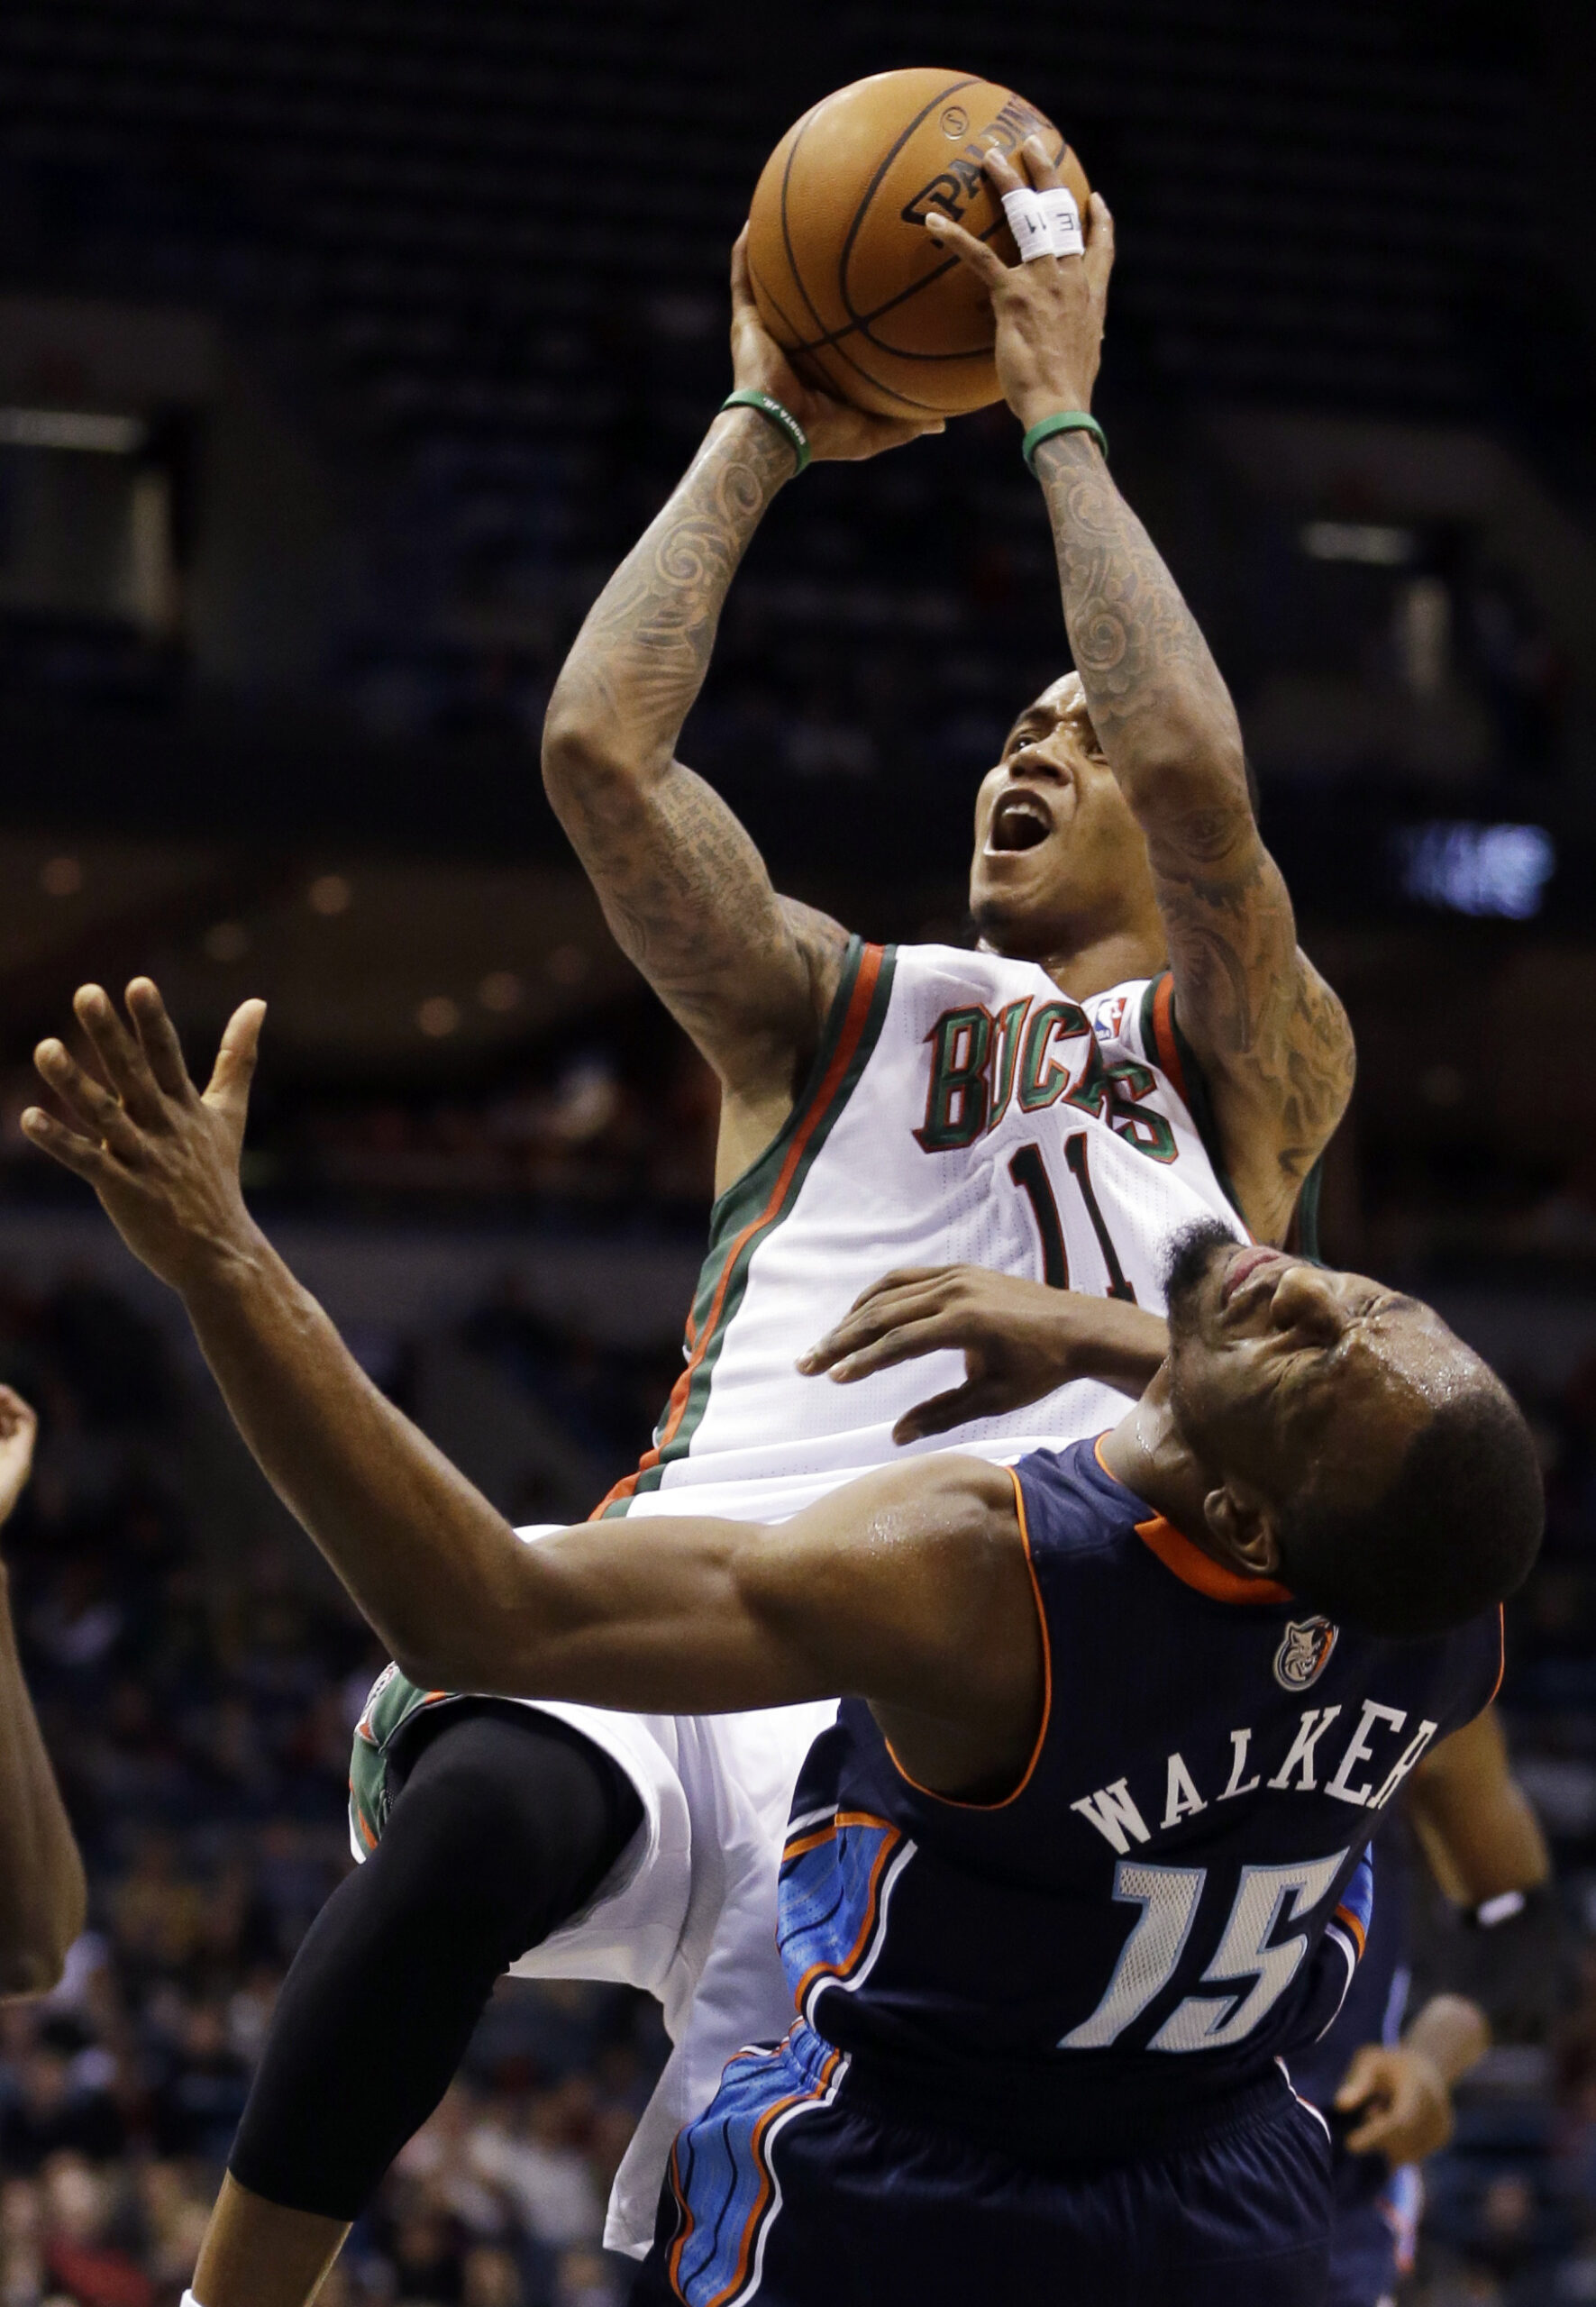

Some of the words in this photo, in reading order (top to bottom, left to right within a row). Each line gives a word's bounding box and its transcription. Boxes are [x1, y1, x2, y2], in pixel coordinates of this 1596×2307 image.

[1008, 1132, 1137, 1303] 11
[1070, 1699, 1438, 1856] WALKER
[1056, 1846, 1351, 2052] 15
